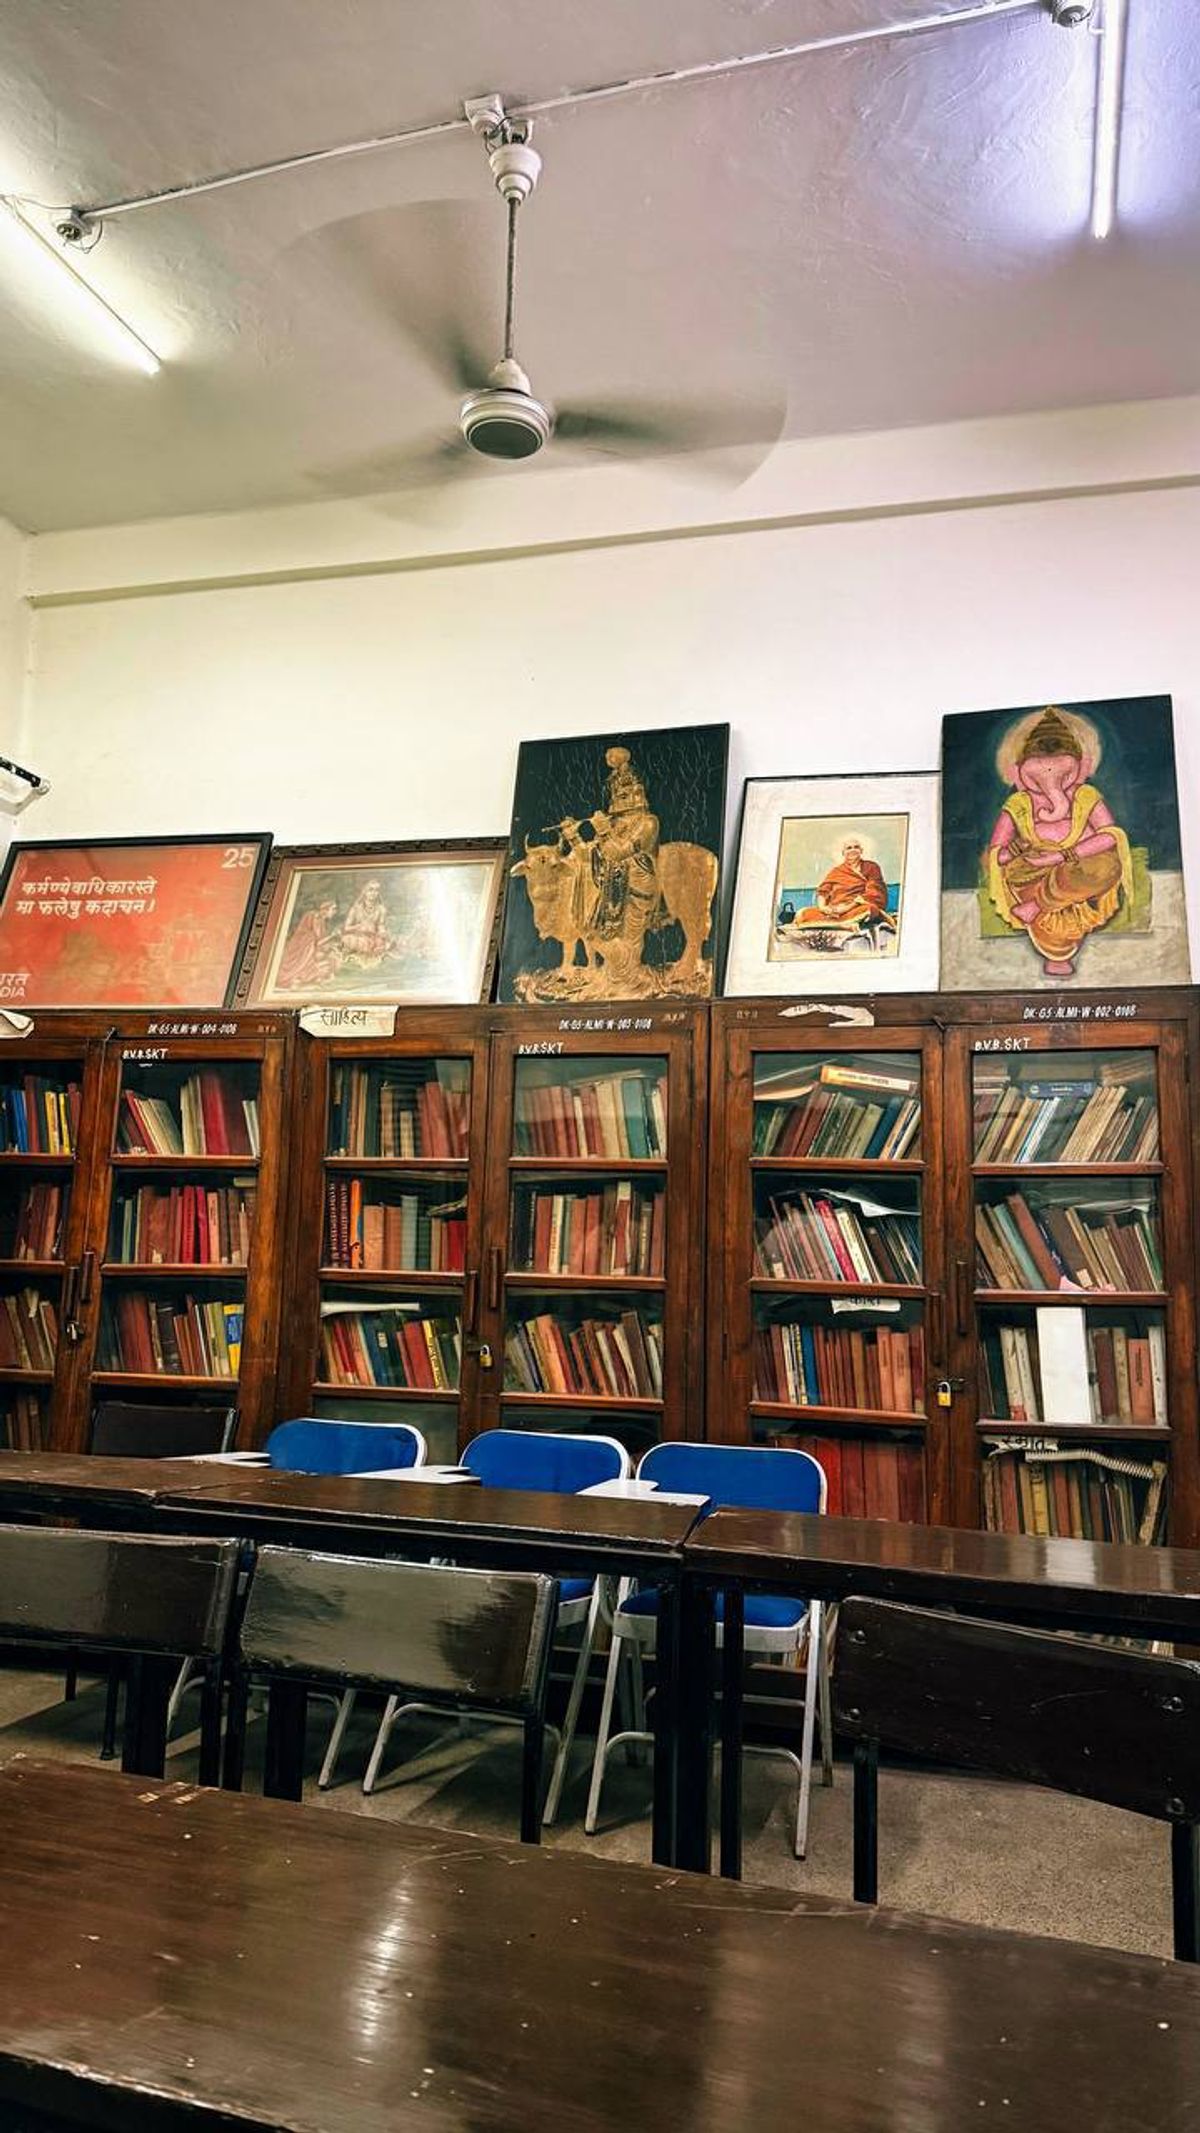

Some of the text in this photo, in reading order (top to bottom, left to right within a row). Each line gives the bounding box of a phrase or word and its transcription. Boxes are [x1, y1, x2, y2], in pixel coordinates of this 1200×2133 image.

[221, 848, 254, 869] 25
[21, 876, 157, 896] कर्मण्येवाधिकारस्ते
[16, 900, 33, 914] मा
[38, 899, 80, 918] फलेषु
[0, 986, 26, 998] DIA
